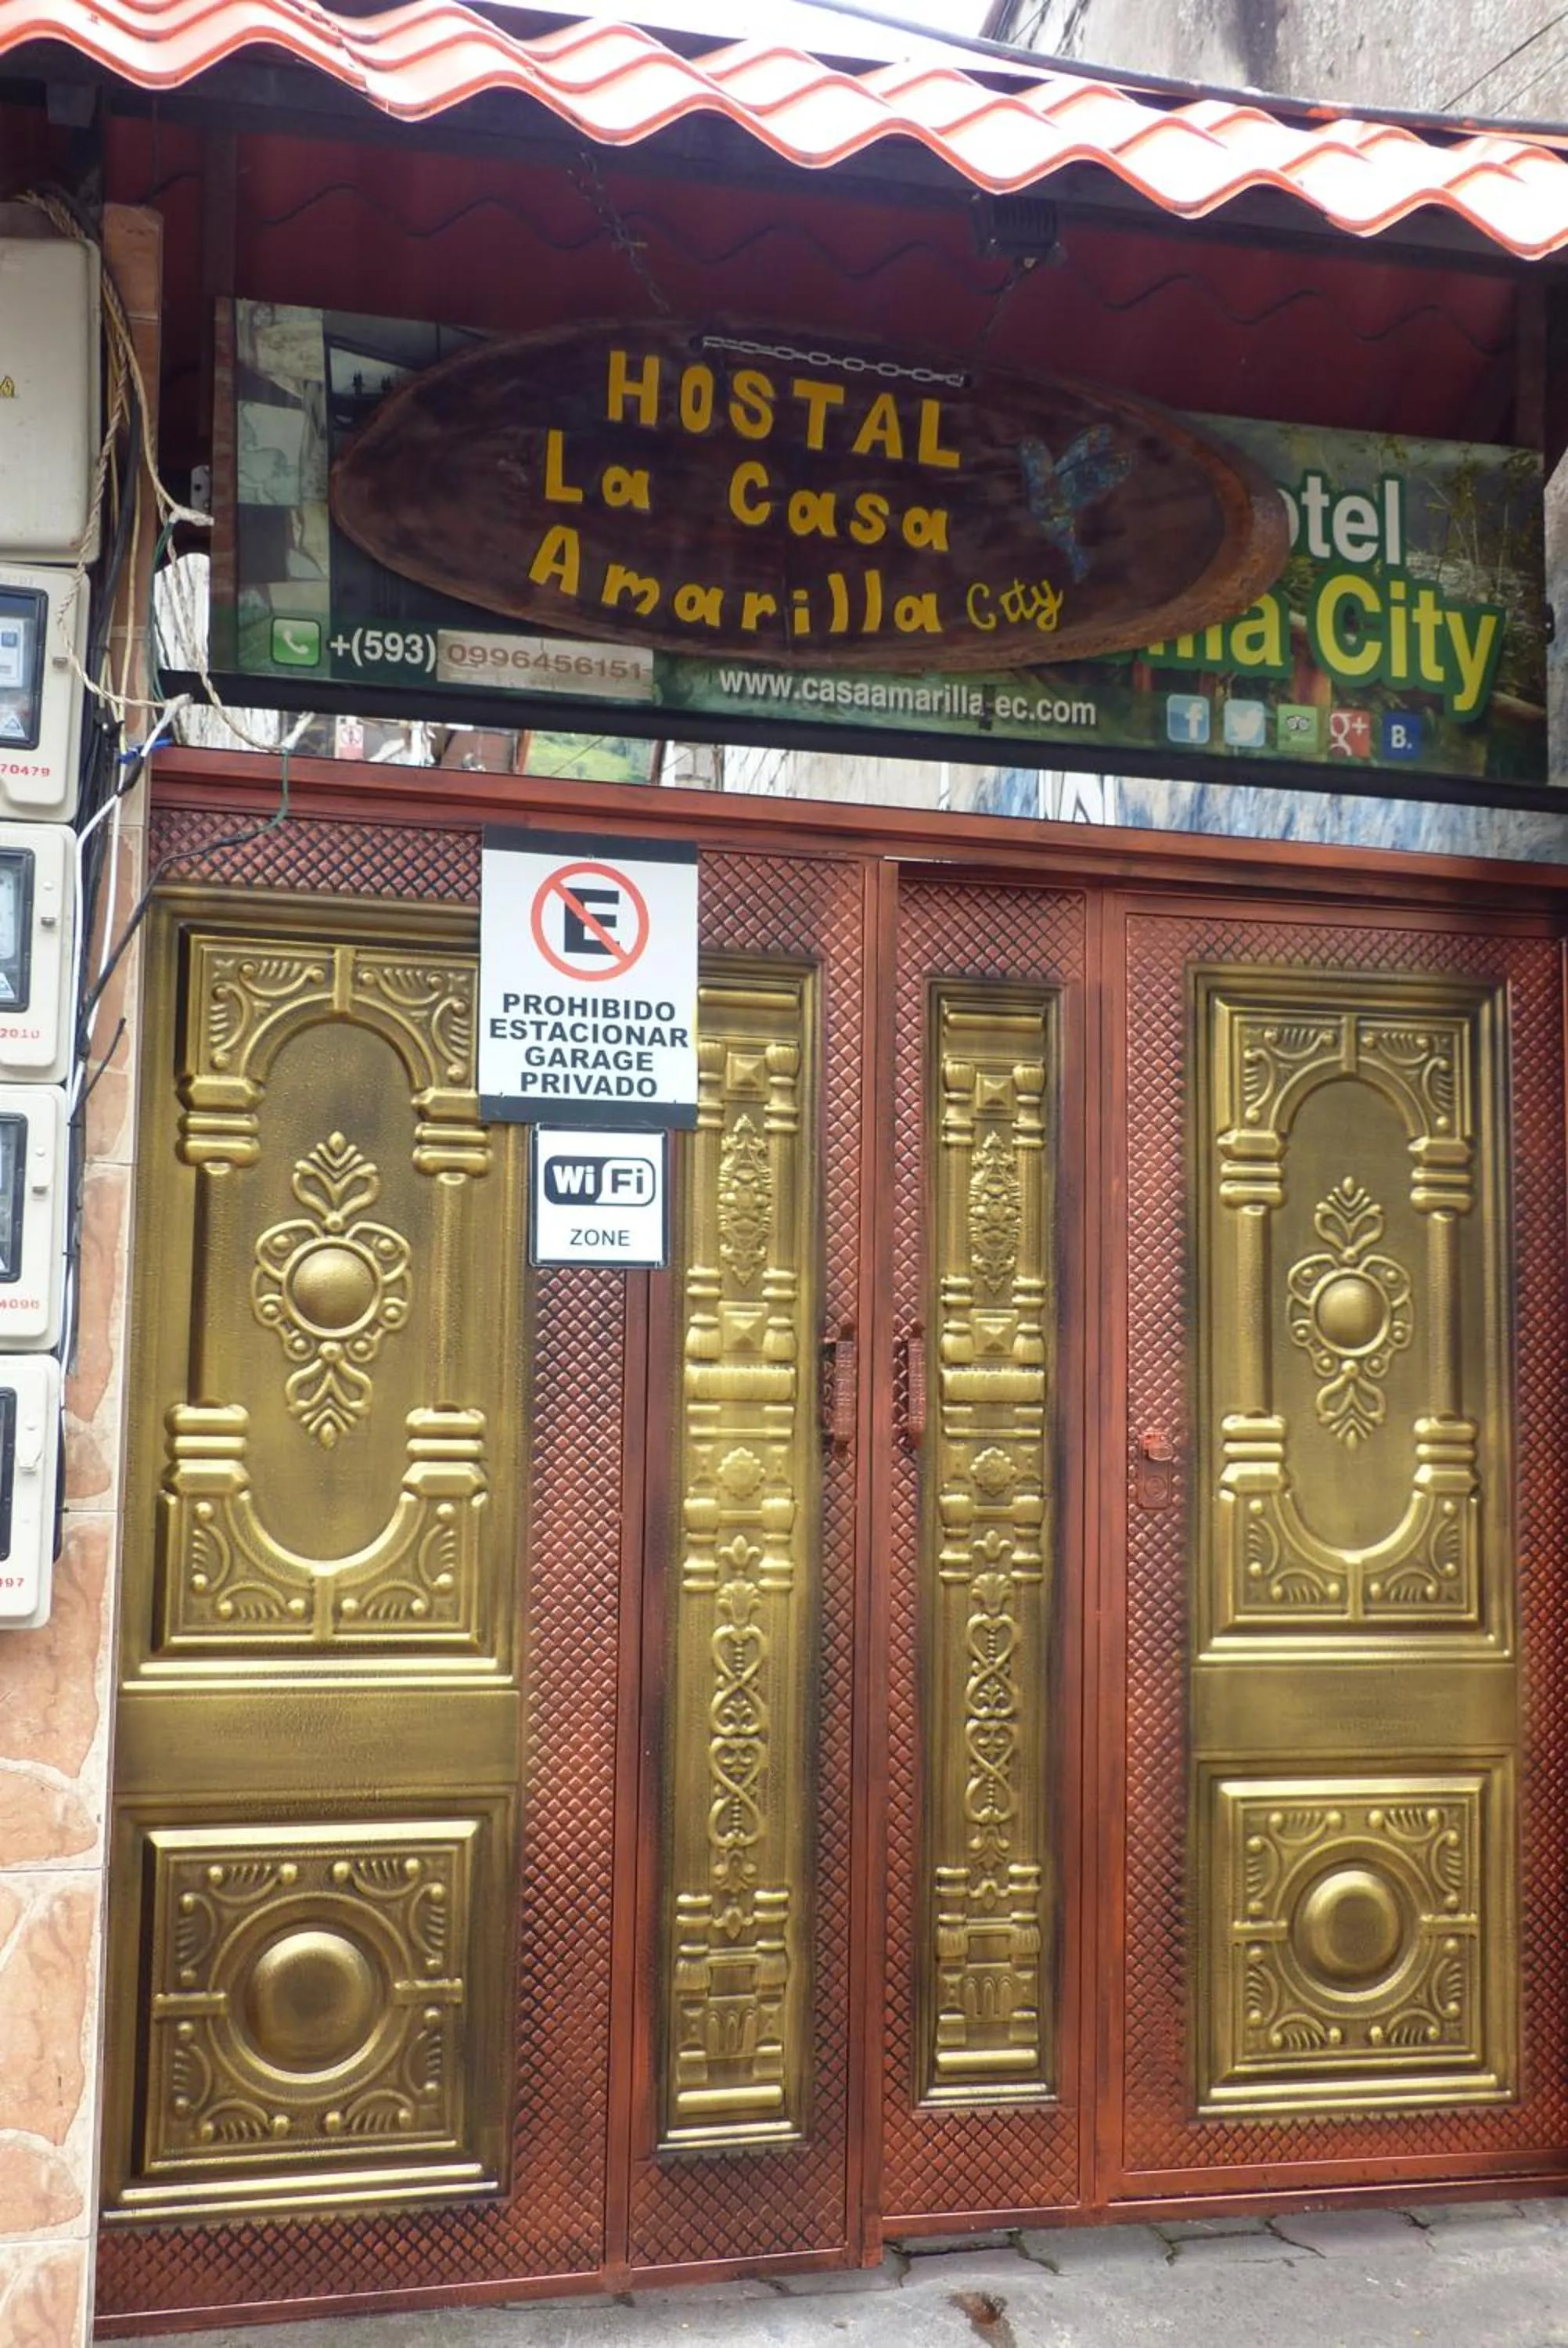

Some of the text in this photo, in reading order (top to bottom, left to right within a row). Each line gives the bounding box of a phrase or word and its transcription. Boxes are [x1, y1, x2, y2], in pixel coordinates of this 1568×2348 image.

[607, 350, 961, 471] HOSTAL
[545, 429, 949, 552] La Casa
[528, 524, 943, 636] Amarilla
[329, 627, 643, 681] +(593) 0996456151
[1316, 574, 1498, 712] City
[502, 992, 676, 1022] PROHIBIDO
[488, 1017, 689, 1049] ESTACIONAR
[523, 1046, 654, 1073] GARAGE
[520, 1071, 658, 1098] PRIVADO
[569, 1228, 631, 1247] ZONE
